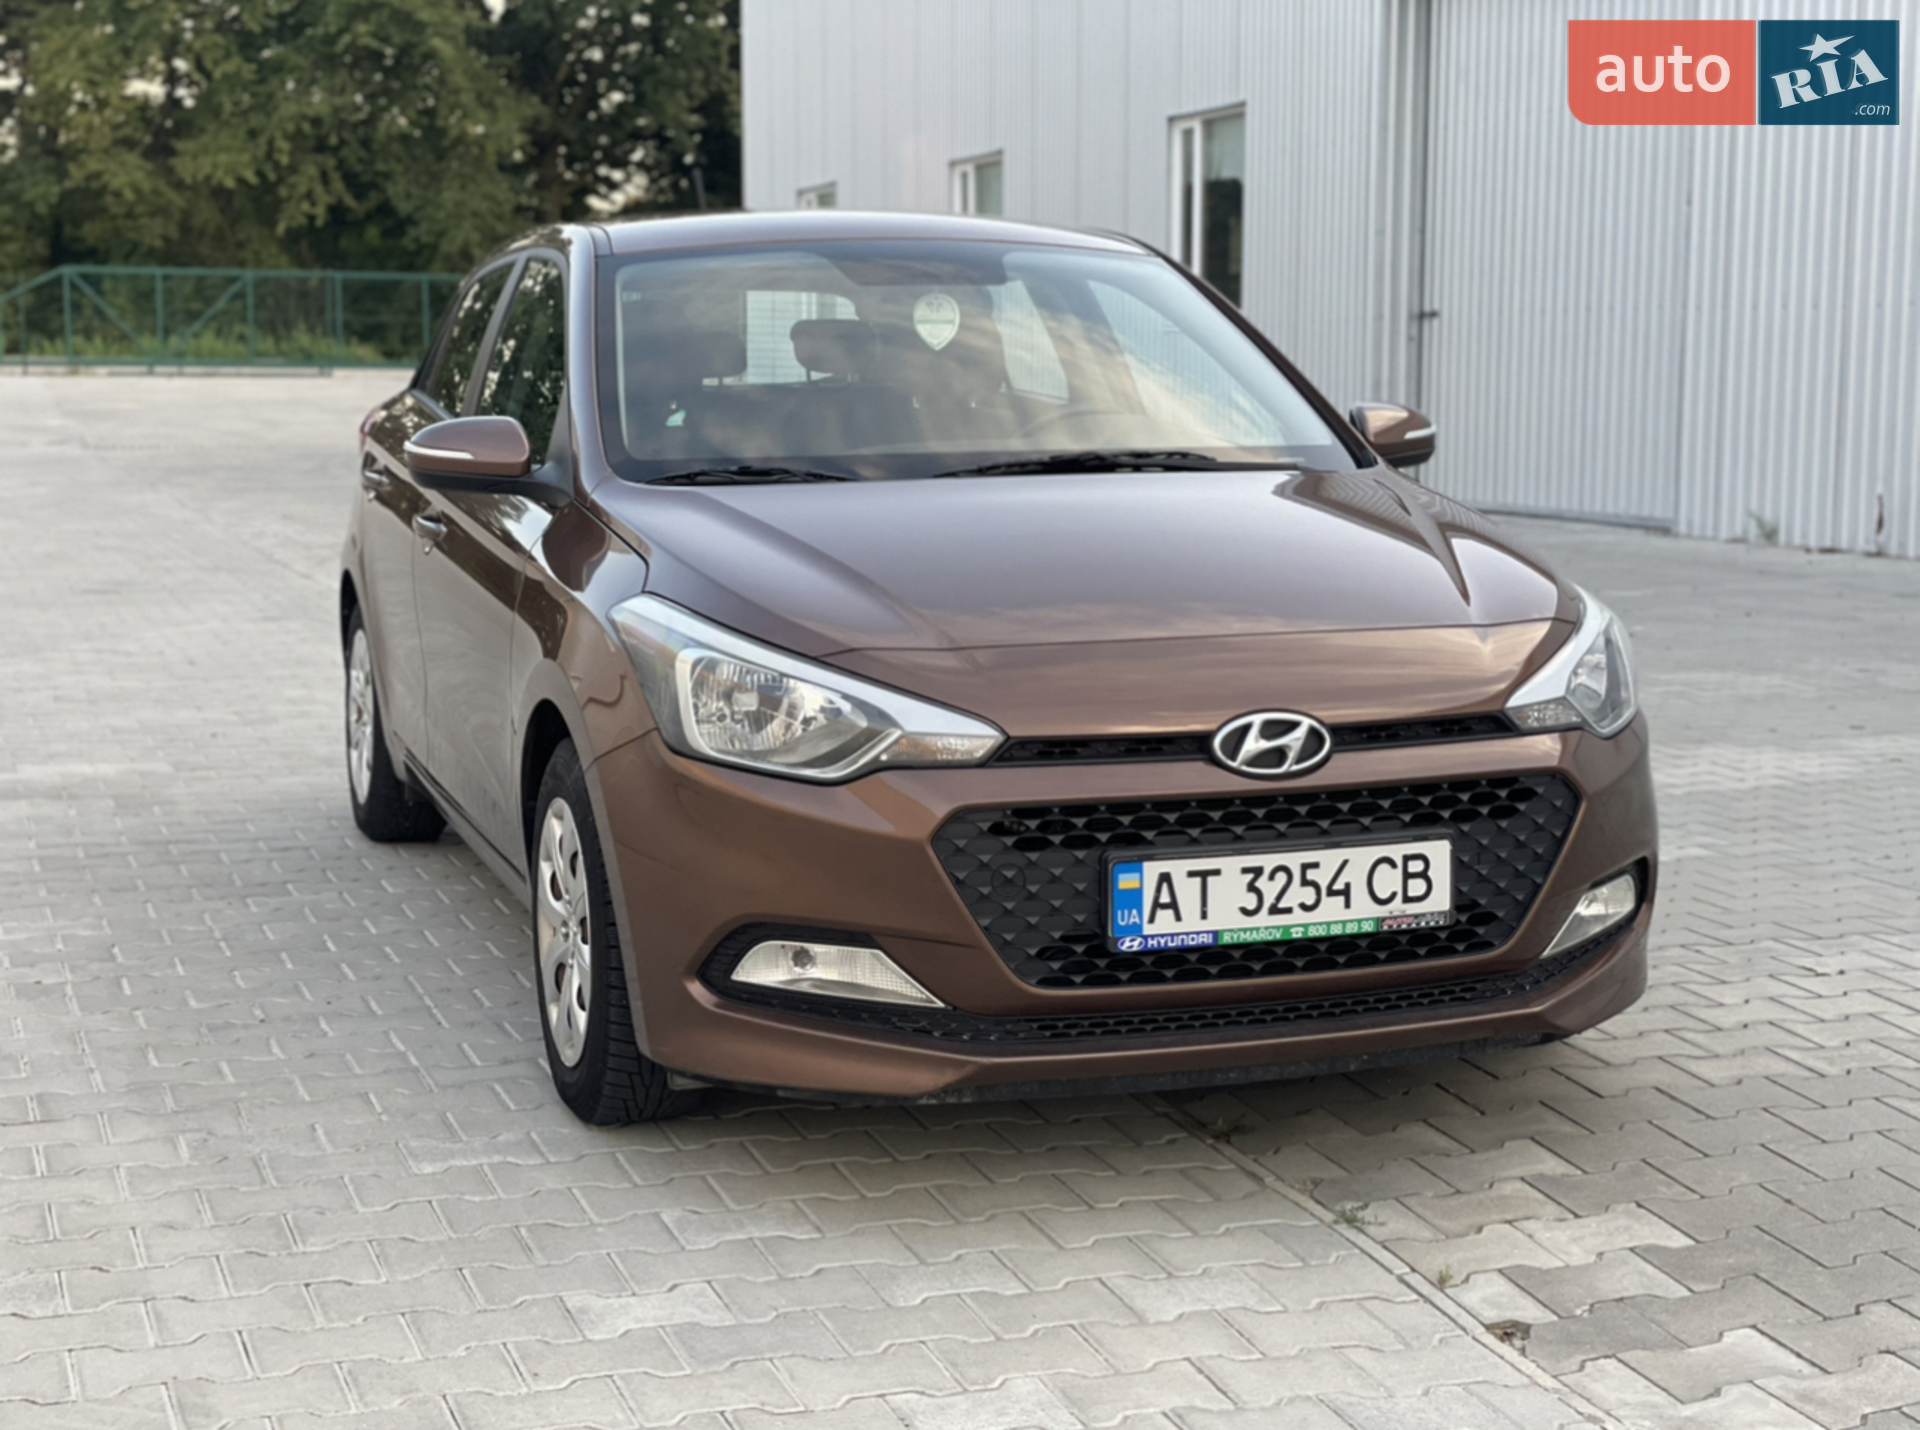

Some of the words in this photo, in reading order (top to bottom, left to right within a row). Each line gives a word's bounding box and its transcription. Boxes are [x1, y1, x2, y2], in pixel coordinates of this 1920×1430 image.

[1147, 867, 1222, 925] AT
[1238, 858, 1352, 918] 3254
[1366, 852, 1434, 907] CB
[1117, 908, 1141, 926] UA
[1307, 923, 1328, 937] 800
[1361, 920, 1375, 932] 90
[1147, 932, 1214, 949] HYUNDAI
